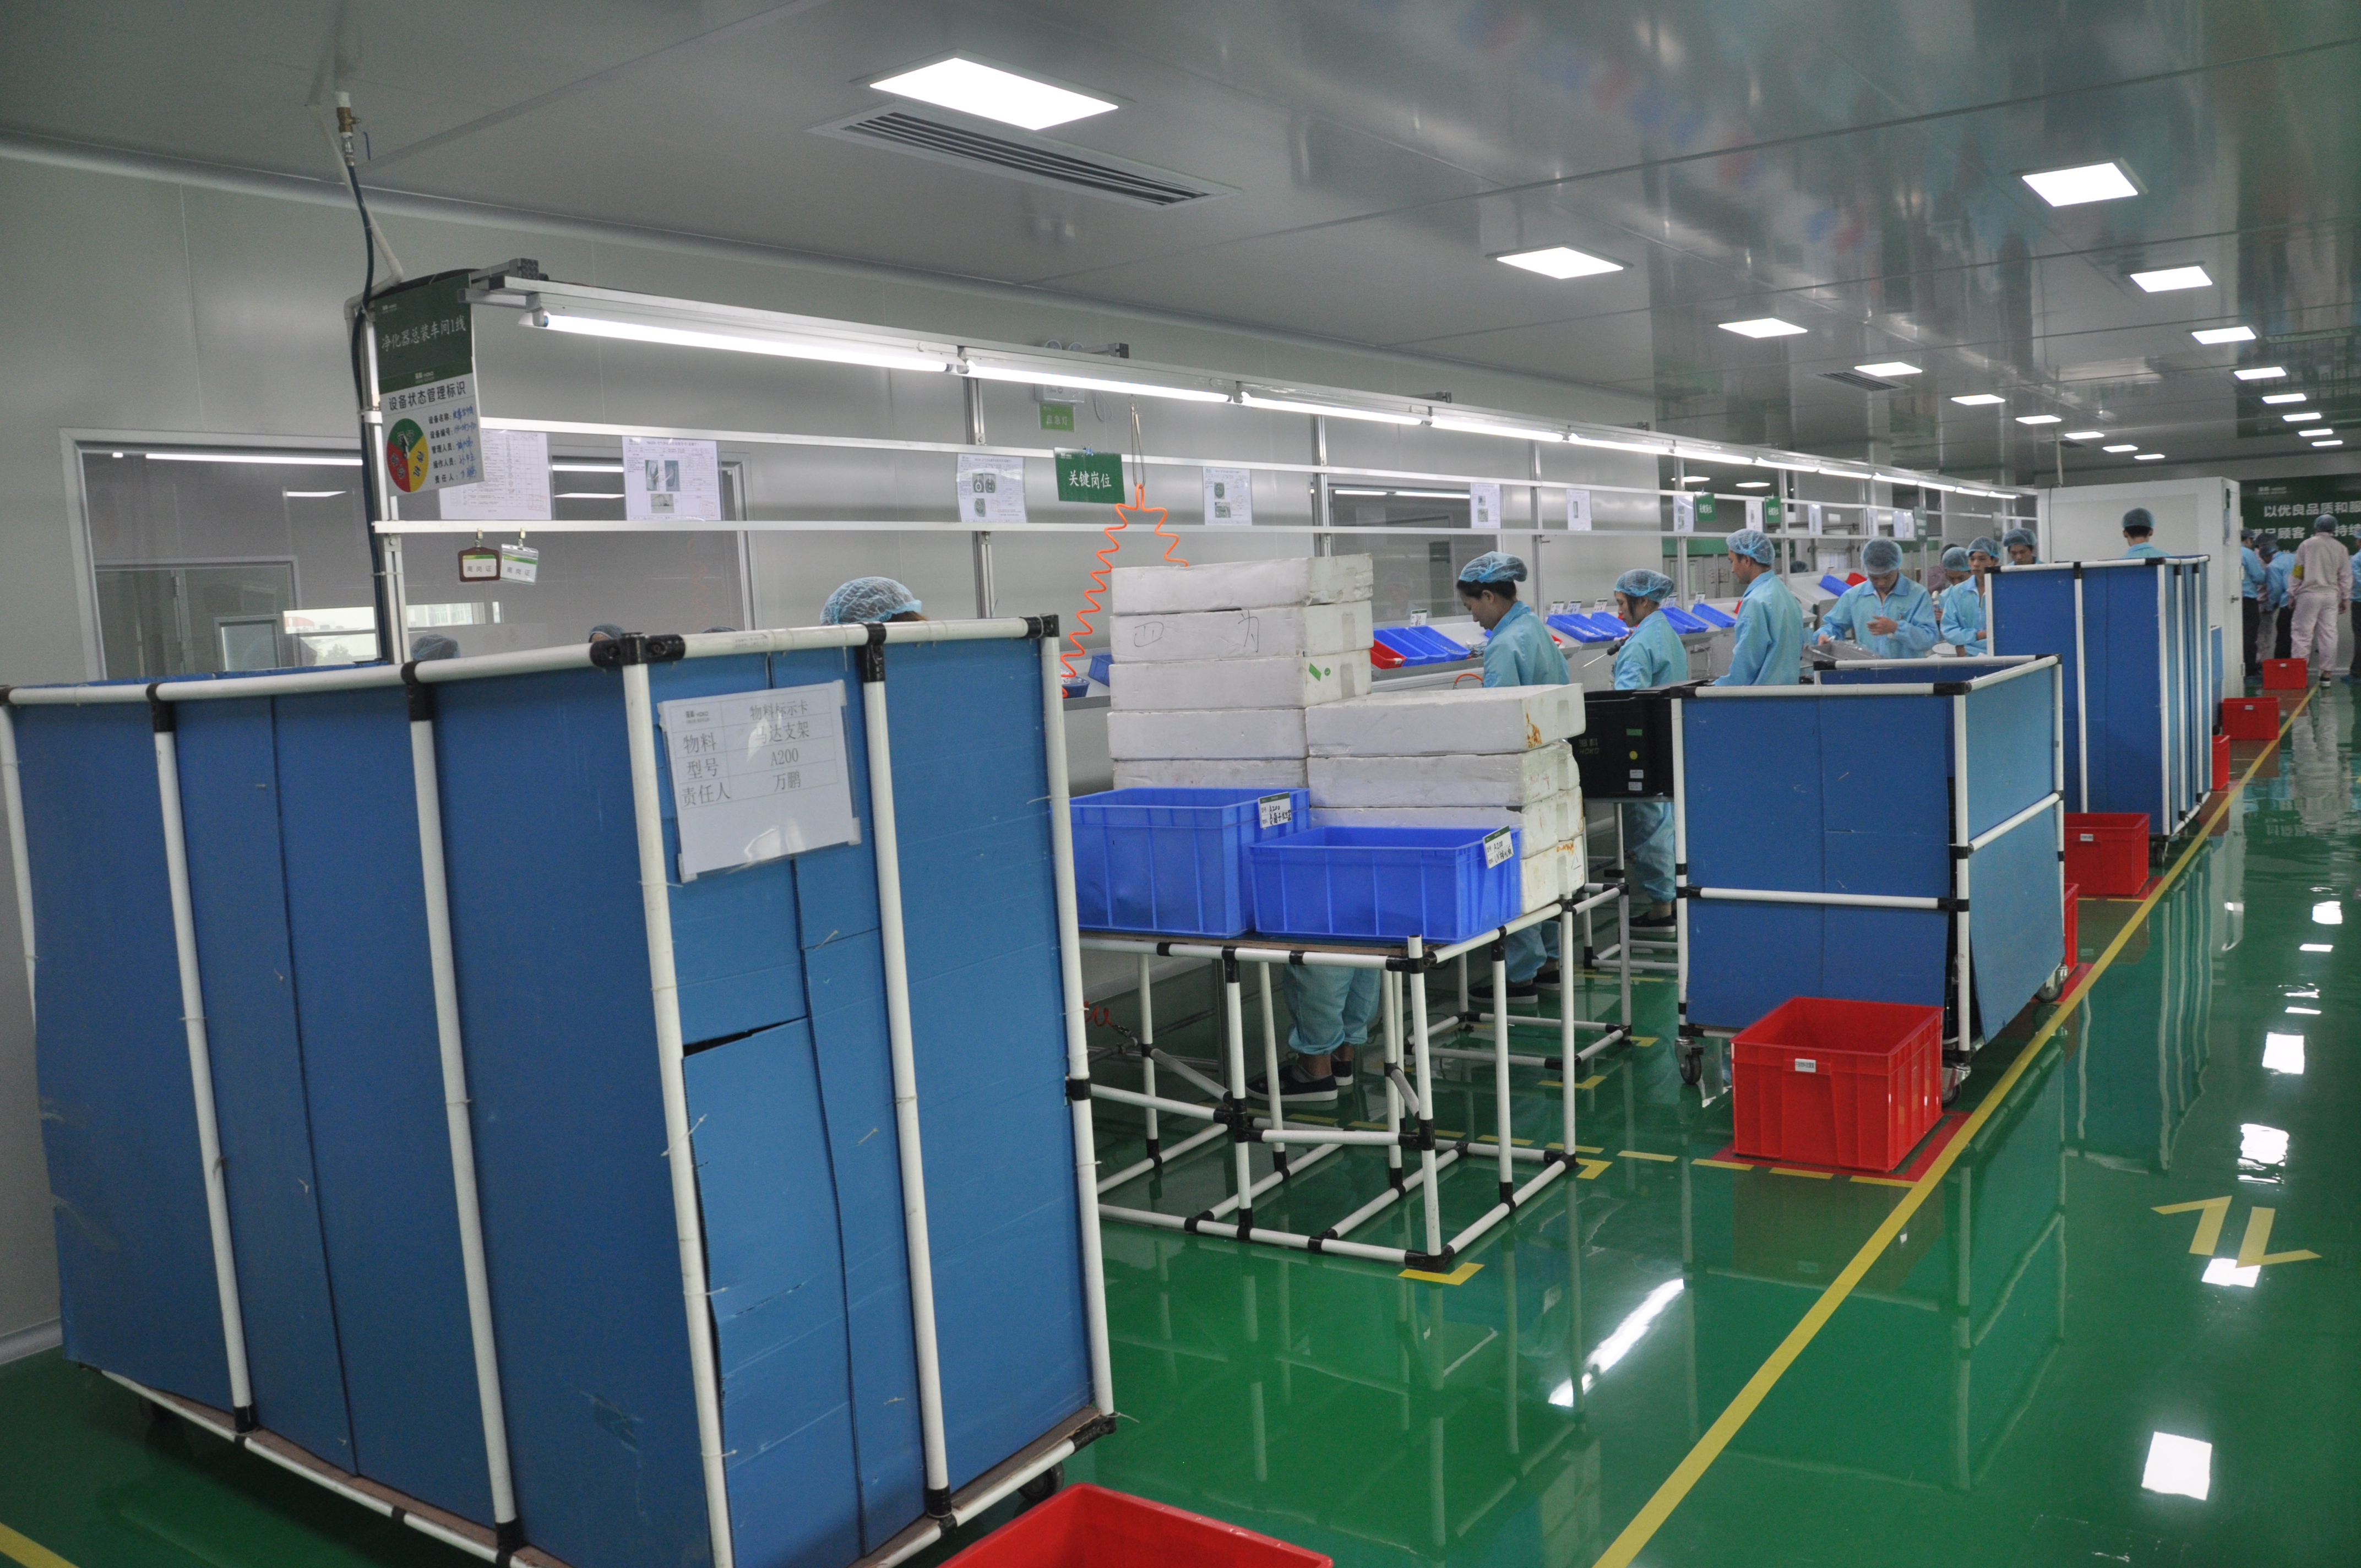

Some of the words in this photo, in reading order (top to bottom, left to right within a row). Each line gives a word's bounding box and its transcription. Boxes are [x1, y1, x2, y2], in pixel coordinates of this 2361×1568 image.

[382, 314, 466, 352] 净化器总装车间1线
[389, 381, 466, 411] 设备状态管理标识
[1046, 415, 1068, 426] 应急灯
[1069, 470, 1112, 489] 关键岗位
[2264, 500, 2361, 517] 以优良品质和服
[750, 699, 808, 720] 物料标示卡
[683, 732, 717, 754] 物料
[754, 721, 810, 744] 马达支架
[686, 757, 719, 780] 型号
[771, 748, 799, 765] A200
[681, 781, 731, 807] 责任人
[773, 770, 801, 792] 万鹏
[1494, 841, 1503, 852] A200
